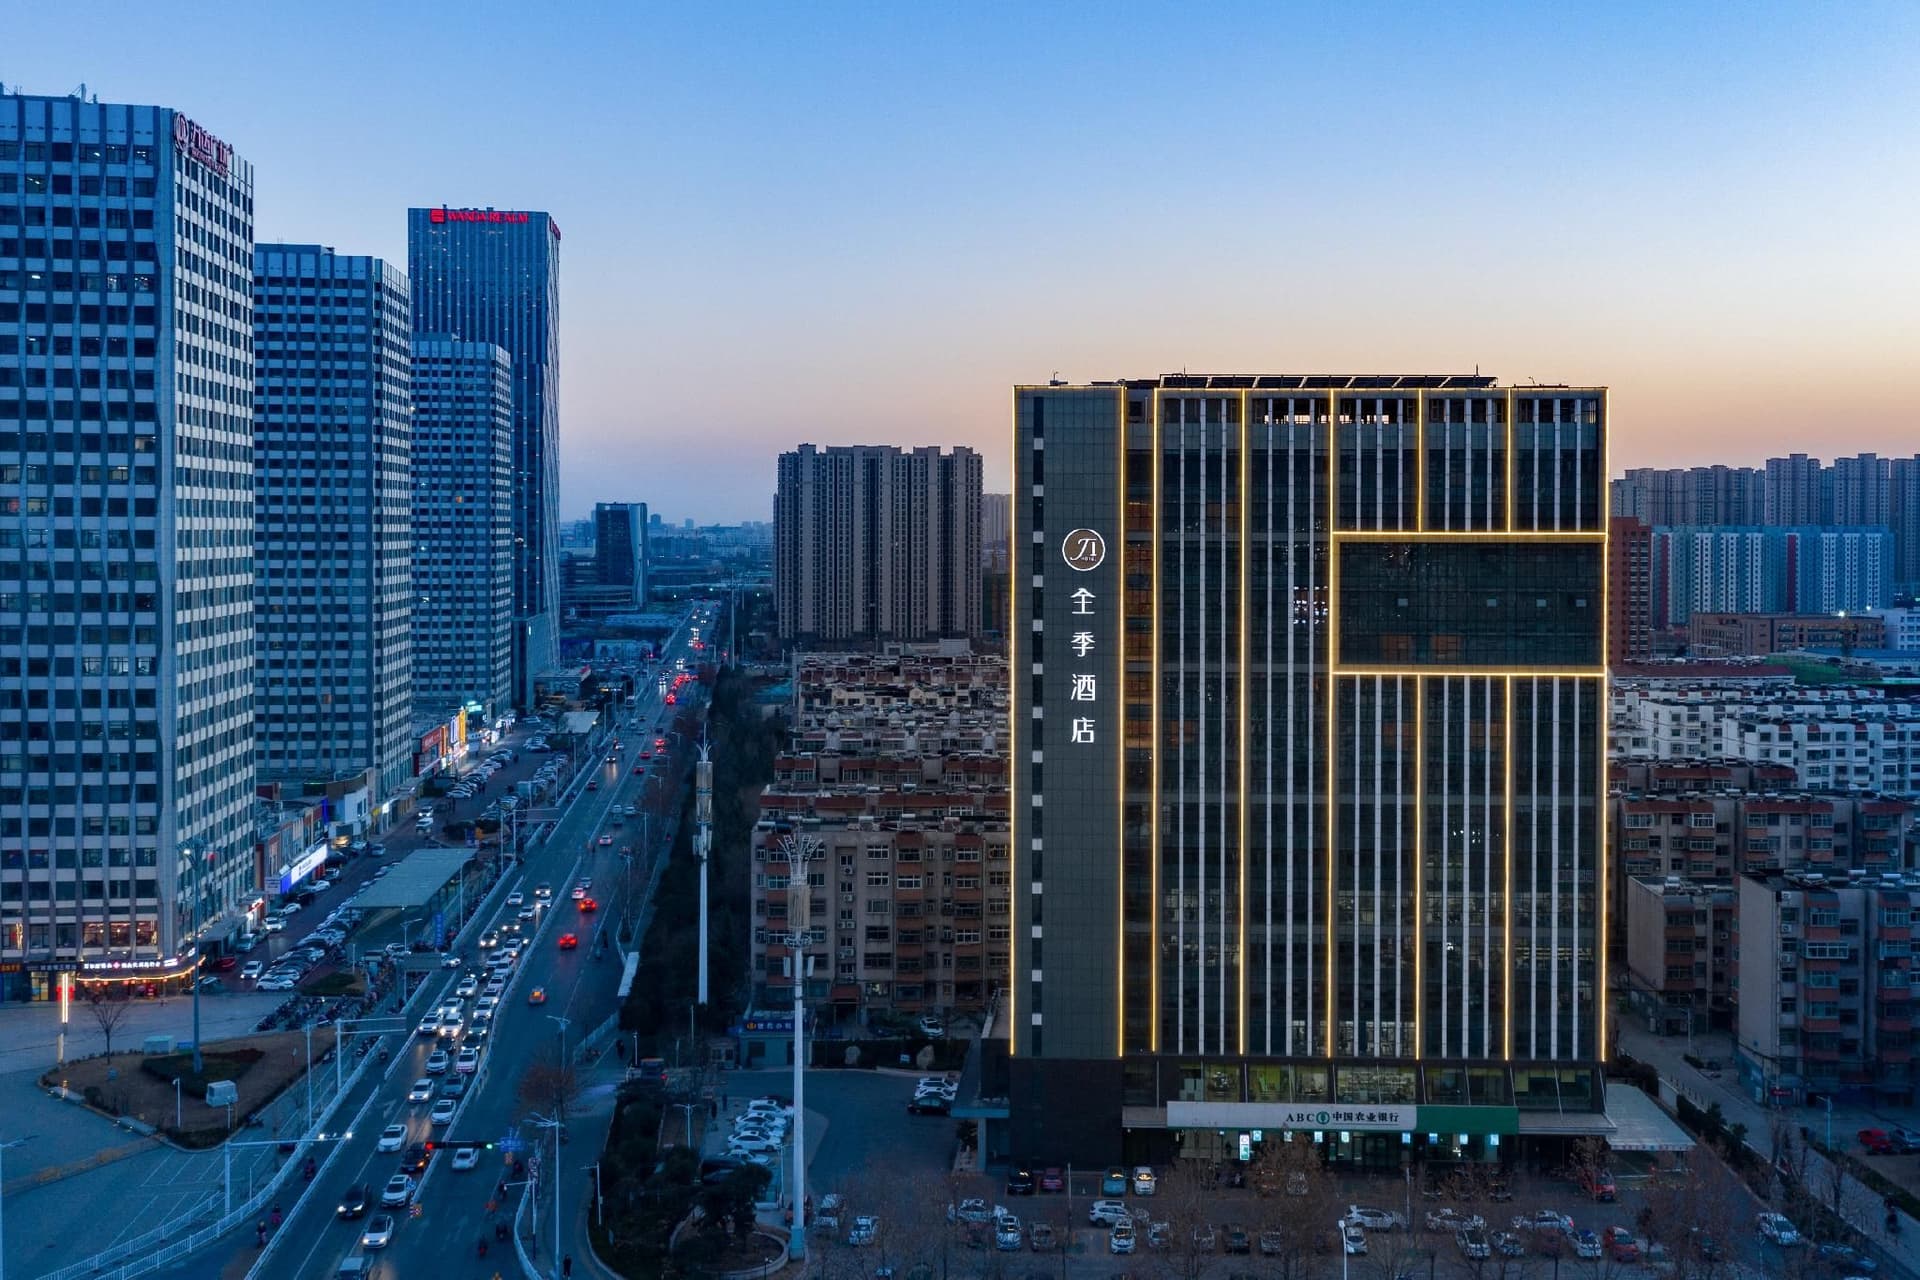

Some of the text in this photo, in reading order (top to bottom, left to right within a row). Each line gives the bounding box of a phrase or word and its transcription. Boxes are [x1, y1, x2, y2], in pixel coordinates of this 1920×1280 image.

[1071, 588, 1095, 743] 全季酒店
[1286, 1112, 1315, 1122] ABC
[1332, 1111, 1399, 1123] 中国农业银行
